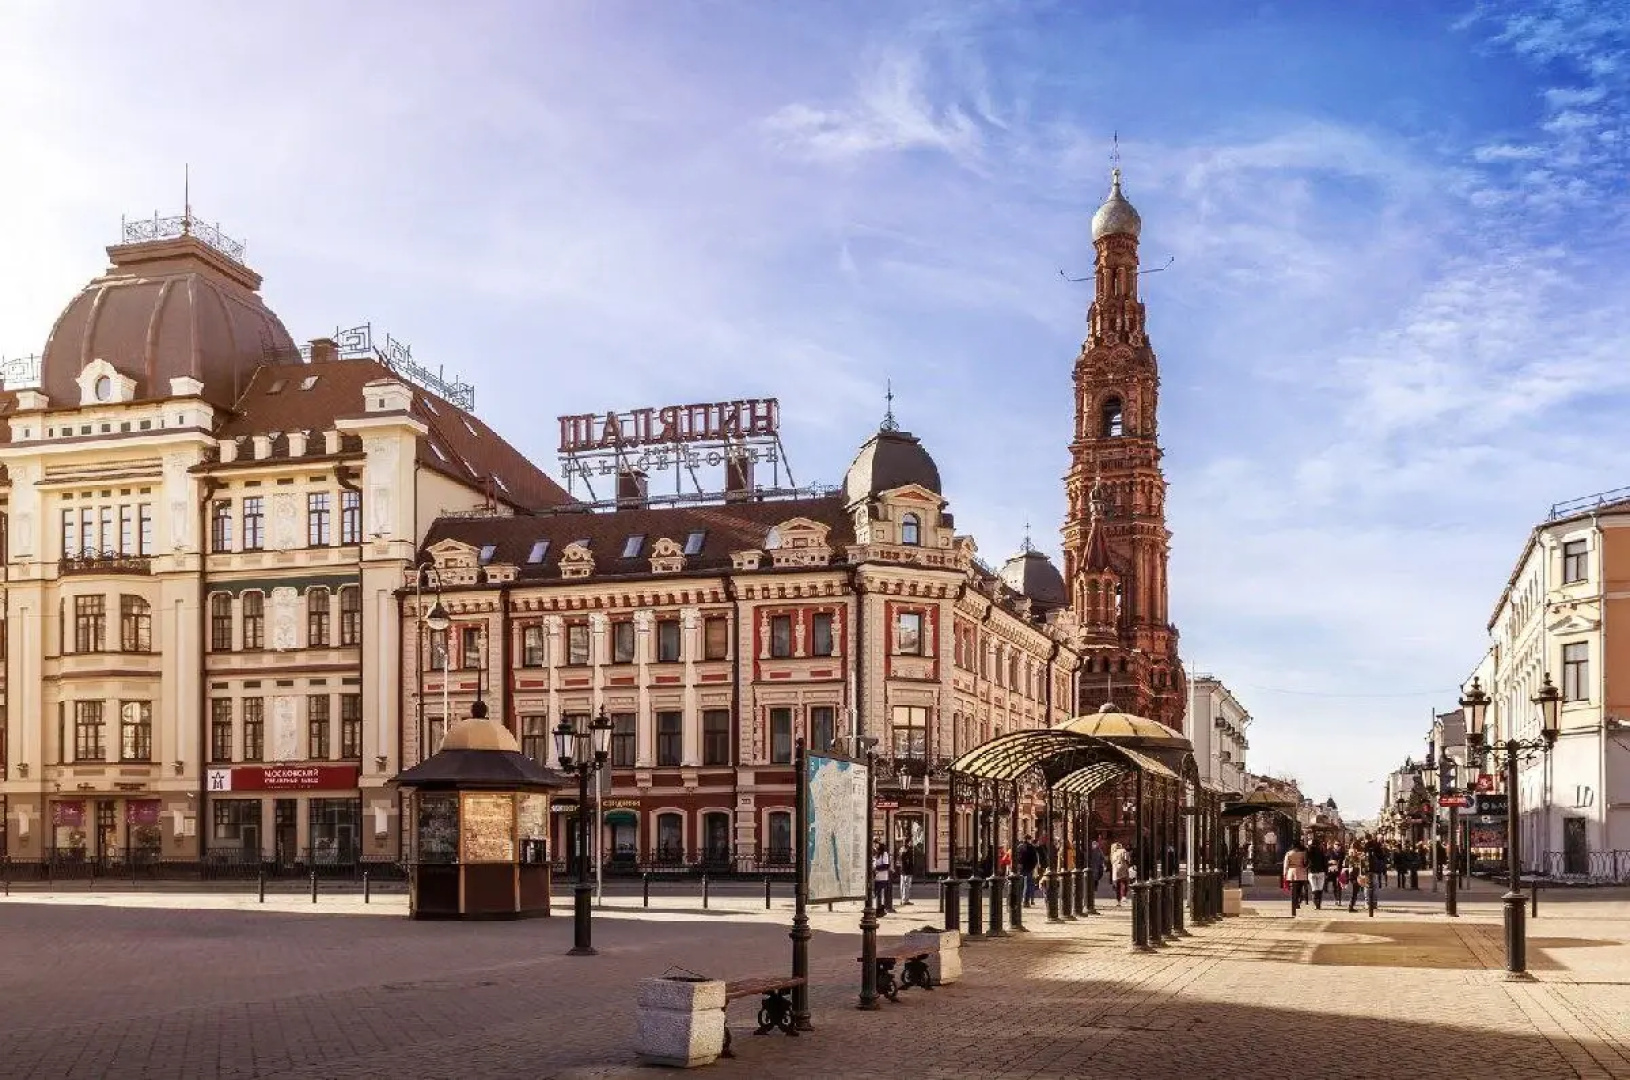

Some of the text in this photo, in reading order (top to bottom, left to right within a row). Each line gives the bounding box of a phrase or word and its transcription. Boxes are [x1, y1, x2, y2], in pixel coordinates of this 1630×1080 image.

[557, 397, 778, 452] ШАЛЯПИН
[561, 446, 779, 478] PALACE HOTEL
